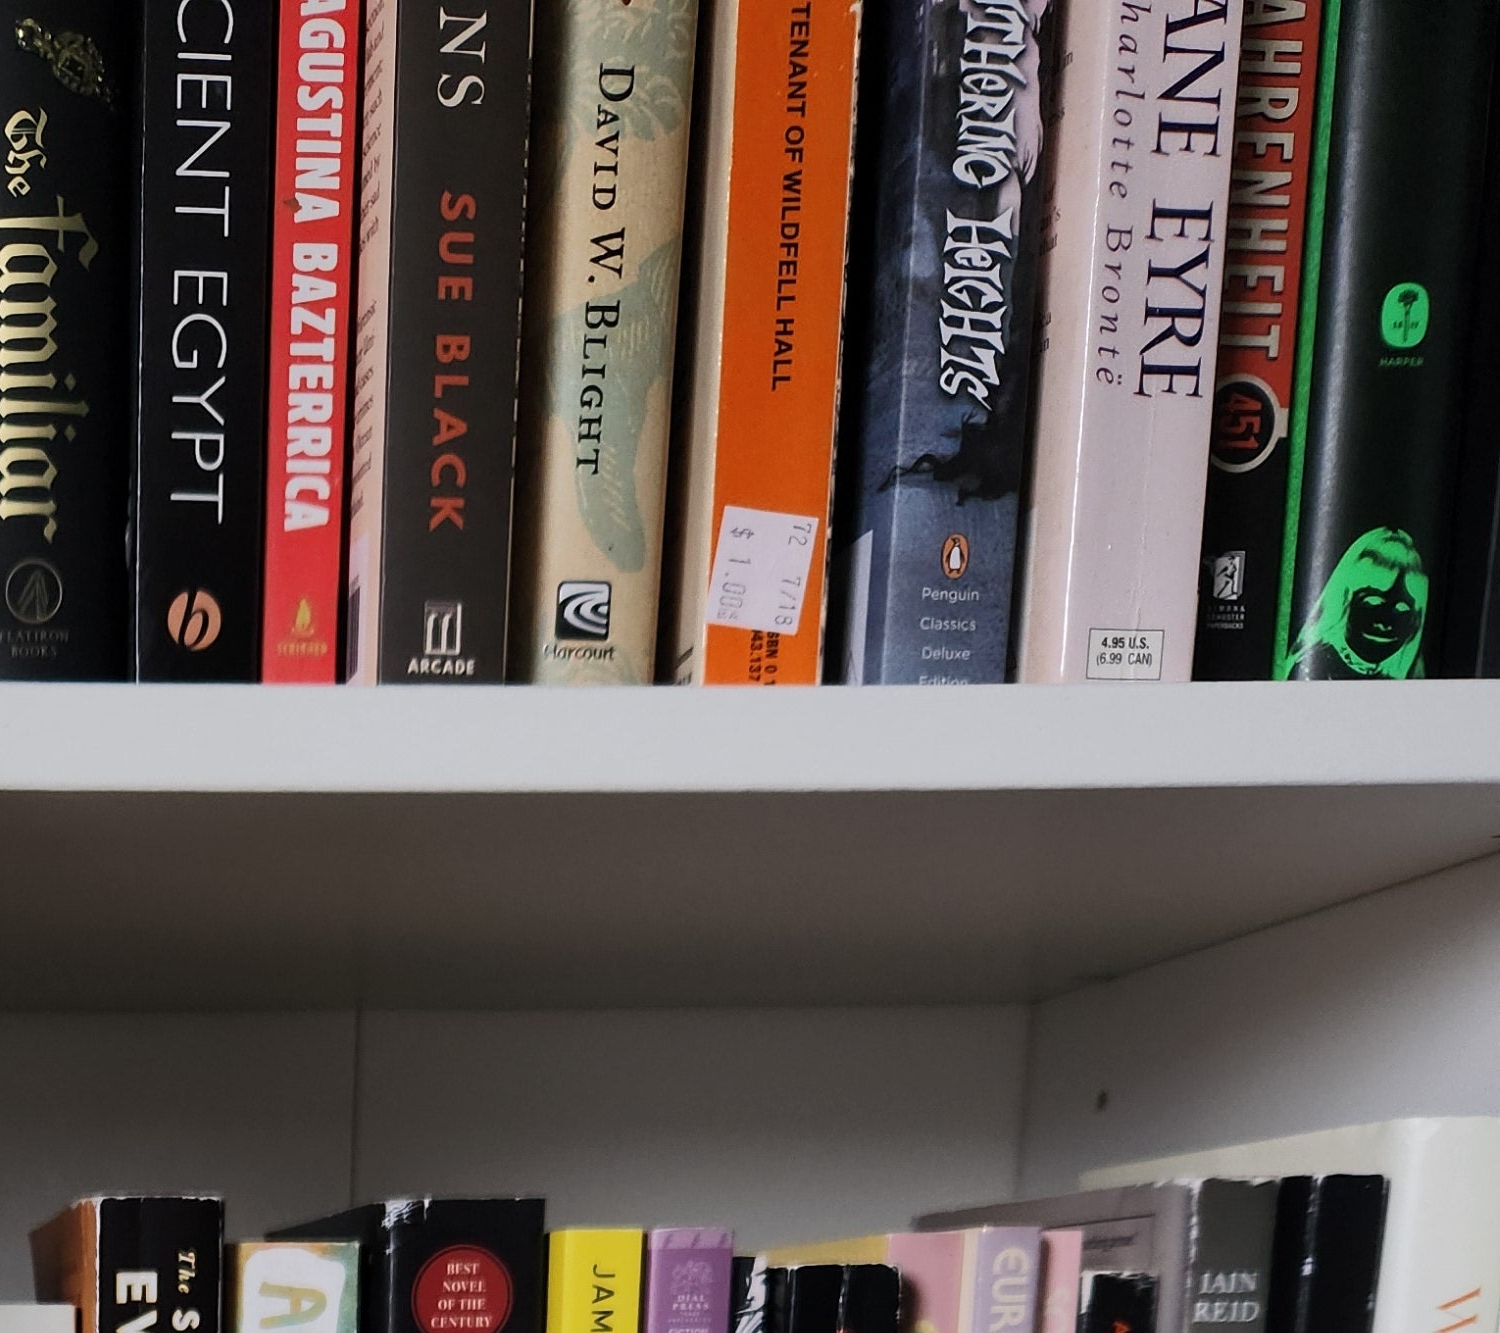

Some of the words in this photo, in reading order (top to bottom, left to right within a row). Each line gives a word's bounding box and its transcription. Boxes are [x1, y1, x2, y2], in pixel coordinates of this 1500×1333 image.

[787, 2, 812, 118] TENANT
[1151, 0, 1229, 158] ANE
[175, 0, 234, 238] CIENT
[1109, 0, 1153, 199] harlotte
[4, 109, 48, 197] The
[591, 63, 636, 211] DAVID
[785, 128, 806, 165] OF
[1220, 0, 1307, 360] AHRENHEIT
[437, 191, 477, 301] SUE
[587, 226, 627, 286] W.
[776, 164, 804, 319] WILDFELL
[1095, 222, 1134, 387] Brontë
[1133, 199, 1215, 399] EYRE
[283, 243, 338, 533] BAZTERRICA
[575, 300, 623, 477] BLIGHT
[770, 319, 797, 392] HALL
[170, 269, 228, 525] EGYPT
[428, 334, 471, 532] BLACK
[919, 617, 977, 632] Classics
[921, 587, 980, 604] Penguin
[407, 657, 476, 676] ARCADE
[765, 631, 780, 658] SBN
[921, 646, 972, 661] Deluxe
[1096, 652, 1122, 666] (6.99
[1128, 653, 1153, 667] CAN)
[1101, 637, 1125, 649] 4.95
[1128, 637, 1150, 649] U.S.
[176, 1248, 199, 1296] The
[441, 1280, 488, 1294] NOVEL
[446, 1263, 481, 1276] BEST
[1200, 1270, 1258, 1294] IAIN
[429, 1315, 494, 1330] CENTURY
[436, 1298, 455, 1312] OF
[457, 1298, 487, 1312] THE
[1191, 1301, 1260, 1325] REID
